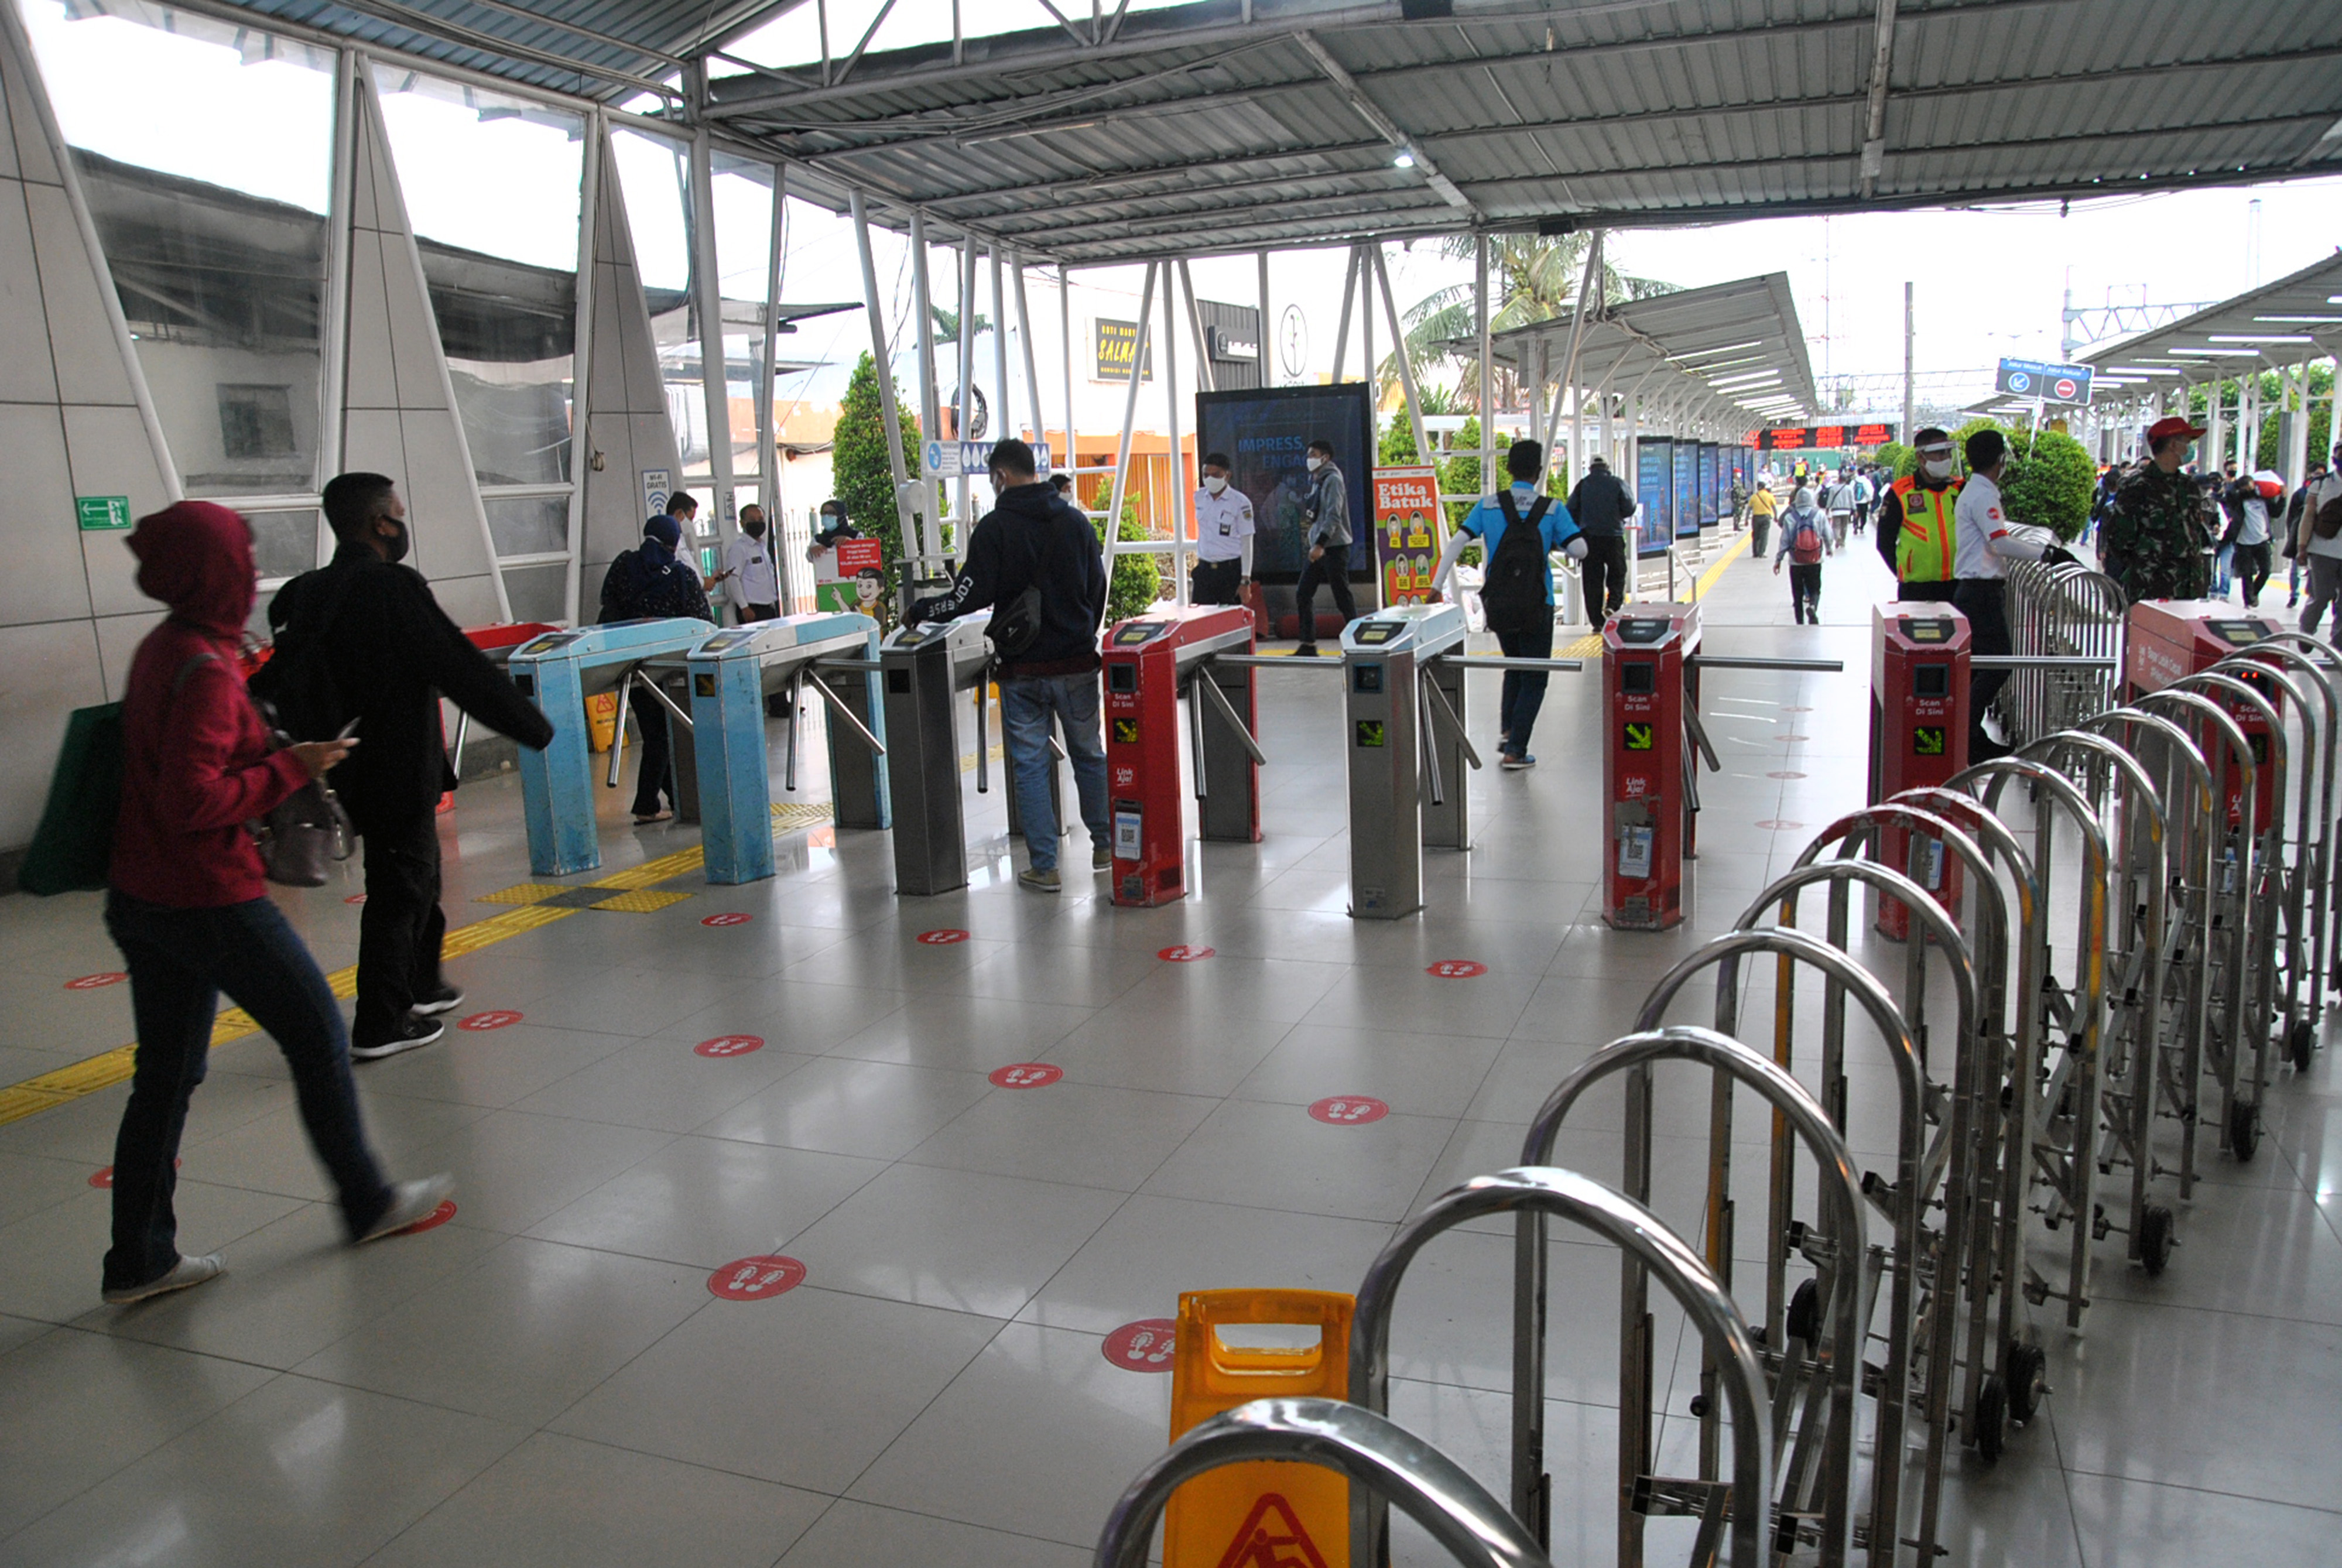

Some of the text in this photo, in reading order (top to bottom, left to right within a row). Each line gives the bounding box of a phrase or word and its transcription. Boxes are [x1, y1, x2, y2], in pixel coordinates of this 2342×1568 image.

[1238, 436, 1305, 453] IMPRESS,
[646, 481, 667, 489] GRATIS
[1378, 482, 1427, 497] Etika
[1379, 496, 1434, 509] Batuk
[929, 576, 974, 617] CONERSE
[1117, 768, 1133, 776] Link
[1626, 776, 1646, 786] Link
